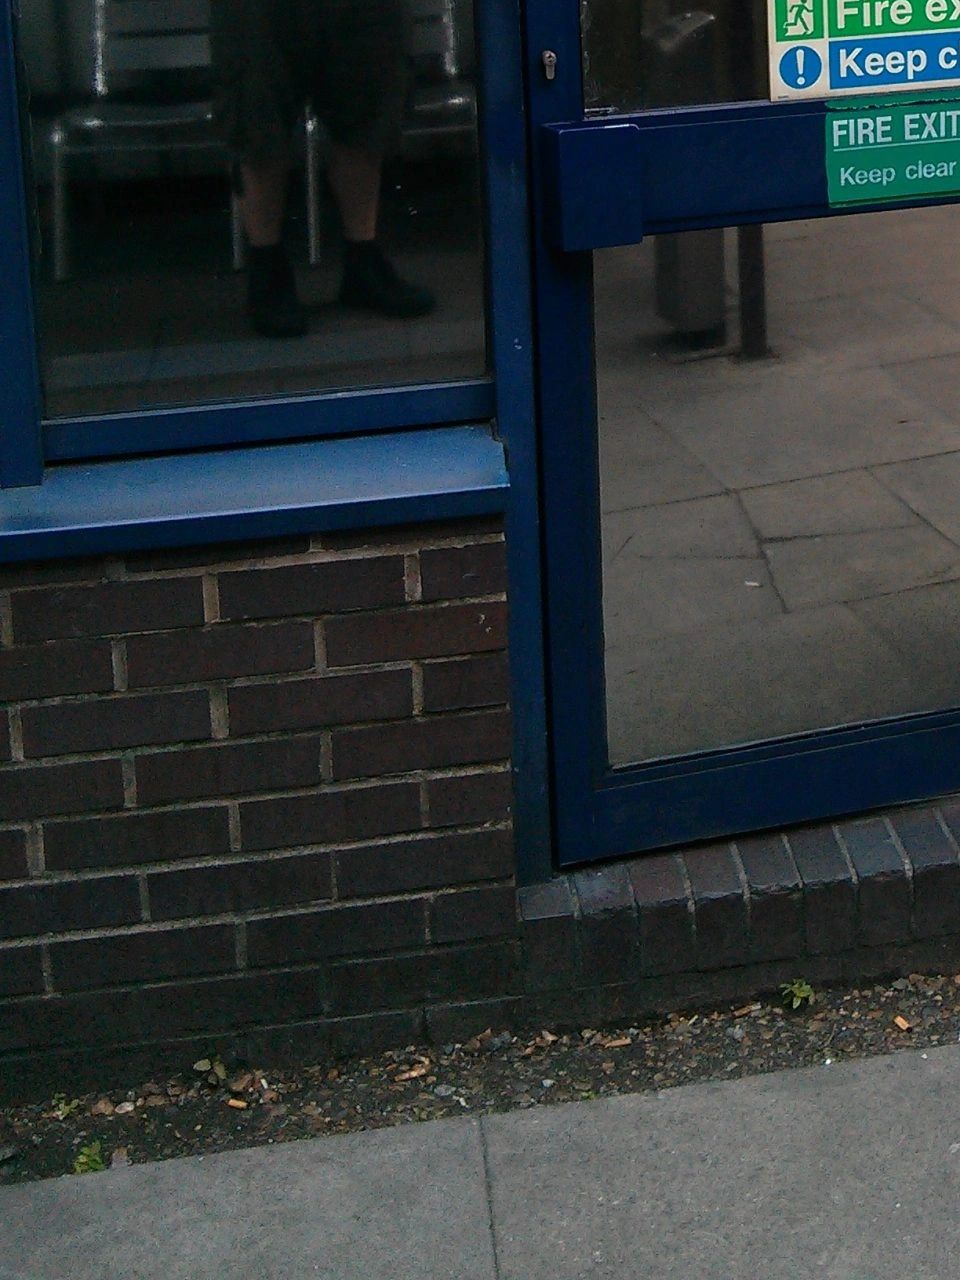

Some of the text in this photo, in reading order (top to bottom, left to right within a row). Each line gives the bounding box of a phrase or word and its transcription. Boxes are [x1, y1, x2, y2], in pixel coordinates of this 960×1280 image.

[839, 48, 927, 79] Keep
[833, 116, 892, 146] FIRE
[840, 160, 956, 186] Keep clear
